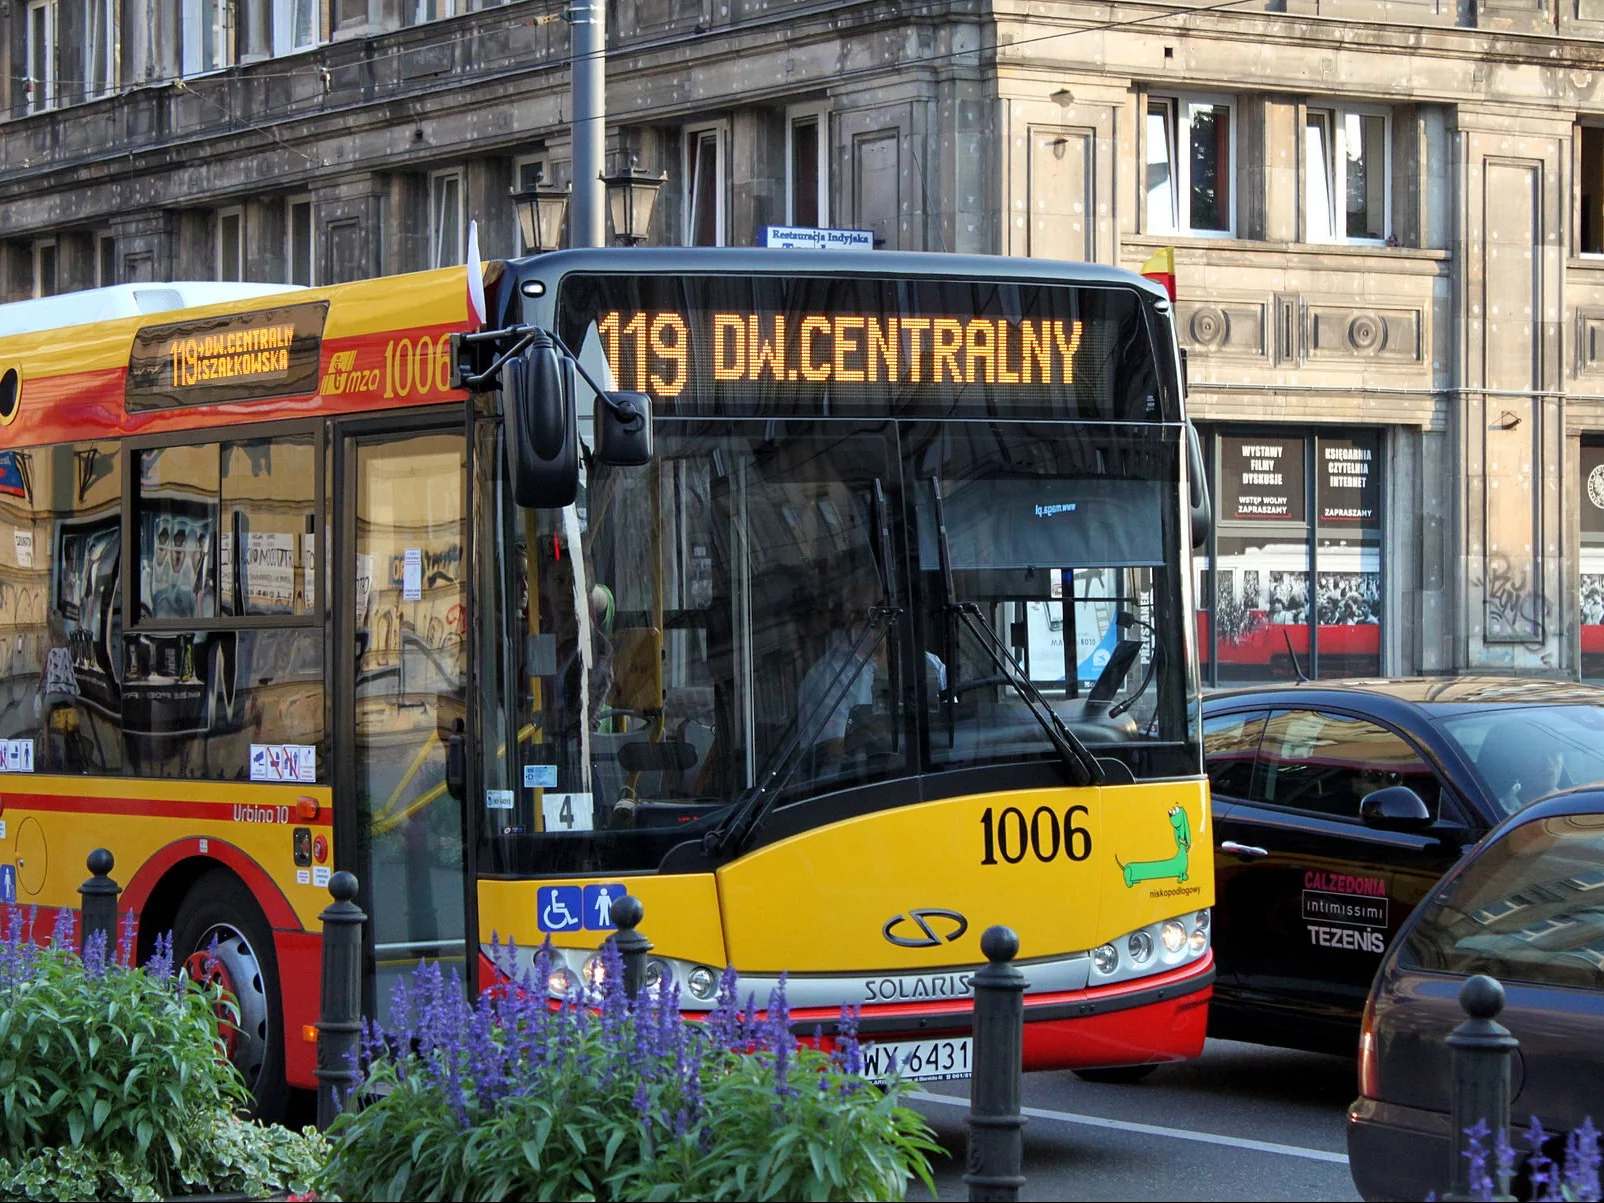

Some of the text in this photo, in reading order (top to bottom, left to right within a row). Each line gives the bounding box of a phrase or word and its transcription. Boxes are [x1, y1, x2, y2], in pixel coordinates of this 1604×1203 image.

[772, 230, 869, 245] Restauracja Indyjska
[170, 338, 198, 387] 119
[599, 312, 1083, 396] 119 DW.CENTRALNY
[383, 332, 450, 399] 1006
[1242, 445, 1283, 458] WYSTAWY
[1324, 447, 1372, 462] KSIĘGARNIA
[1250, 459, 1275, 472] FILMY
[1328, 462, 1369, 474] CZYTELNIA
[1242, 473, 1283, 485] DYSKUSJE
[1329, 475, 1367, 488] INTERNET
[1238, 496, 1287, 505] WSTĘP WOLNY
[1238, 505, 1287, 514] ZAPRASZAMY
[1324, 508, 1373, 518] ZAPRASZAMY
[1140, 591, 1151, 665] PRZYSANEK
[233, 804, 289, 824] Urbino 10
[559, 795, 575, 830] 4
[980, 804, 1093, 866] 1006
[1304, 871, 1387, 897] CALZEDONIA
[1307, 900, 1384, 919] intimissimi
[865, 975, 971, 1001] SOLARIS
[863, 1046, 899, 1077] WX
